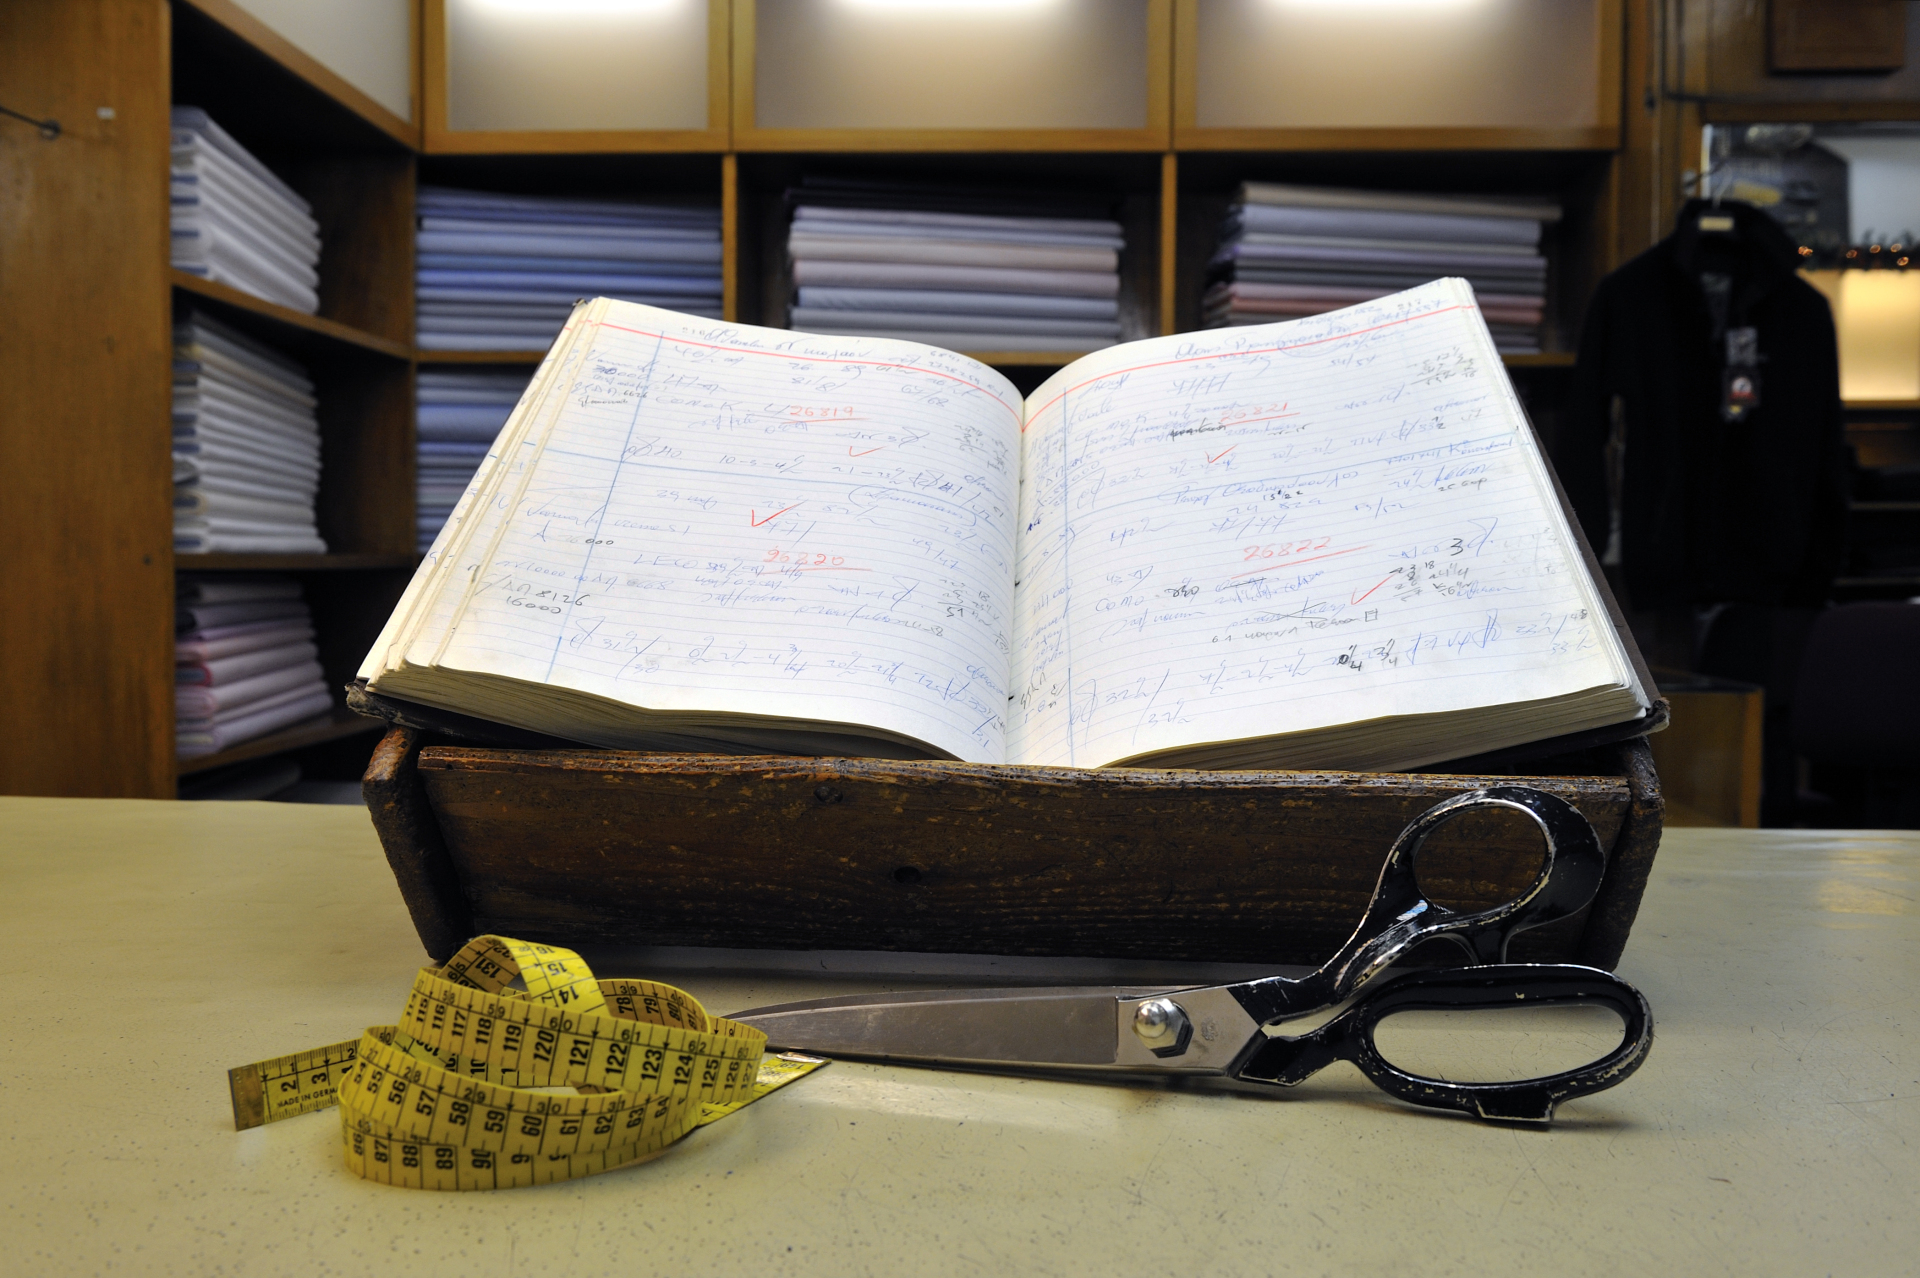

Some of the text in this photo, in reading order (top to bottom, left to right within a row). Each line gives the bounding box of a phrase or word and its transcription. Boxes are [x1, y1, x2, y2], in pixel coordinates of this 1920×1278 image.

[788, 405, 854, 419] 26819
[1220, 402, 1288, 422] 26821
[1244, 536, 1331, 561] 26822
[507, 596, 562, 614] 16000
[536, 590, 591, 606] 8126
[475, 958, 501, 979] 131
[559, 985, 579, 1005] 14
[616, 997, 634, 1014] 78
[643, 998, 659, 1014] 79
[666, 1001, 681, 1021] 80
[487, 1003, 506, 1018] 59
[549, 1016, 573, 1031] 60
[620, 1029, 642, 1042] 61
[688, 1040, 708, 1053] 62
[416, 998, 429, 1023] 115
[432, 1003, 446, 1030] 116
[451, 1011, 467, 1037] 117
[475, 1018, 492, 1045] 118
[503, 1024, 522, 1052] 119
[533, 1030, 555, 1063] 120
[569, 1039, 591, 1067] 121
[605, 1043, 629, 1075] 122
[641, 1049, 663, 1081] 123
[673, 1055, 693, 1086] 124
[701, 1059, 720, 1089] 125
[724, 1061, 740, 1090] 126
[288, 1048, 356, 1072] 1 2
[281, 1072, 327, 1092] 2 3
[403, 1066, 422, 1083] 28
[463, 1087, 487, 1103] 29
[536, 1102, 562, 1115] 30
[301, 1093, 311, 1104] IN
[367, 1070, 383, 1094] 55
[388, 1080, 406, 1105] 56
[415, 1090, 435, 1116] 57
[448, 1101, 469, 1126] 58
[484, 1110, 506, 1134] 59
[521, 1115, 543, 1137] 60
[560, 1118, 580, 1136] 61
[594, 1114, 614, 1135] 62
[626, 1107, 645, 1129] 63
[374, 1139, 389, 1163] 87
[402, 1145, 419, 1168] 88
[434, 1147, 454, 1170] 89
[470, 1148, 492, 1170] 90
